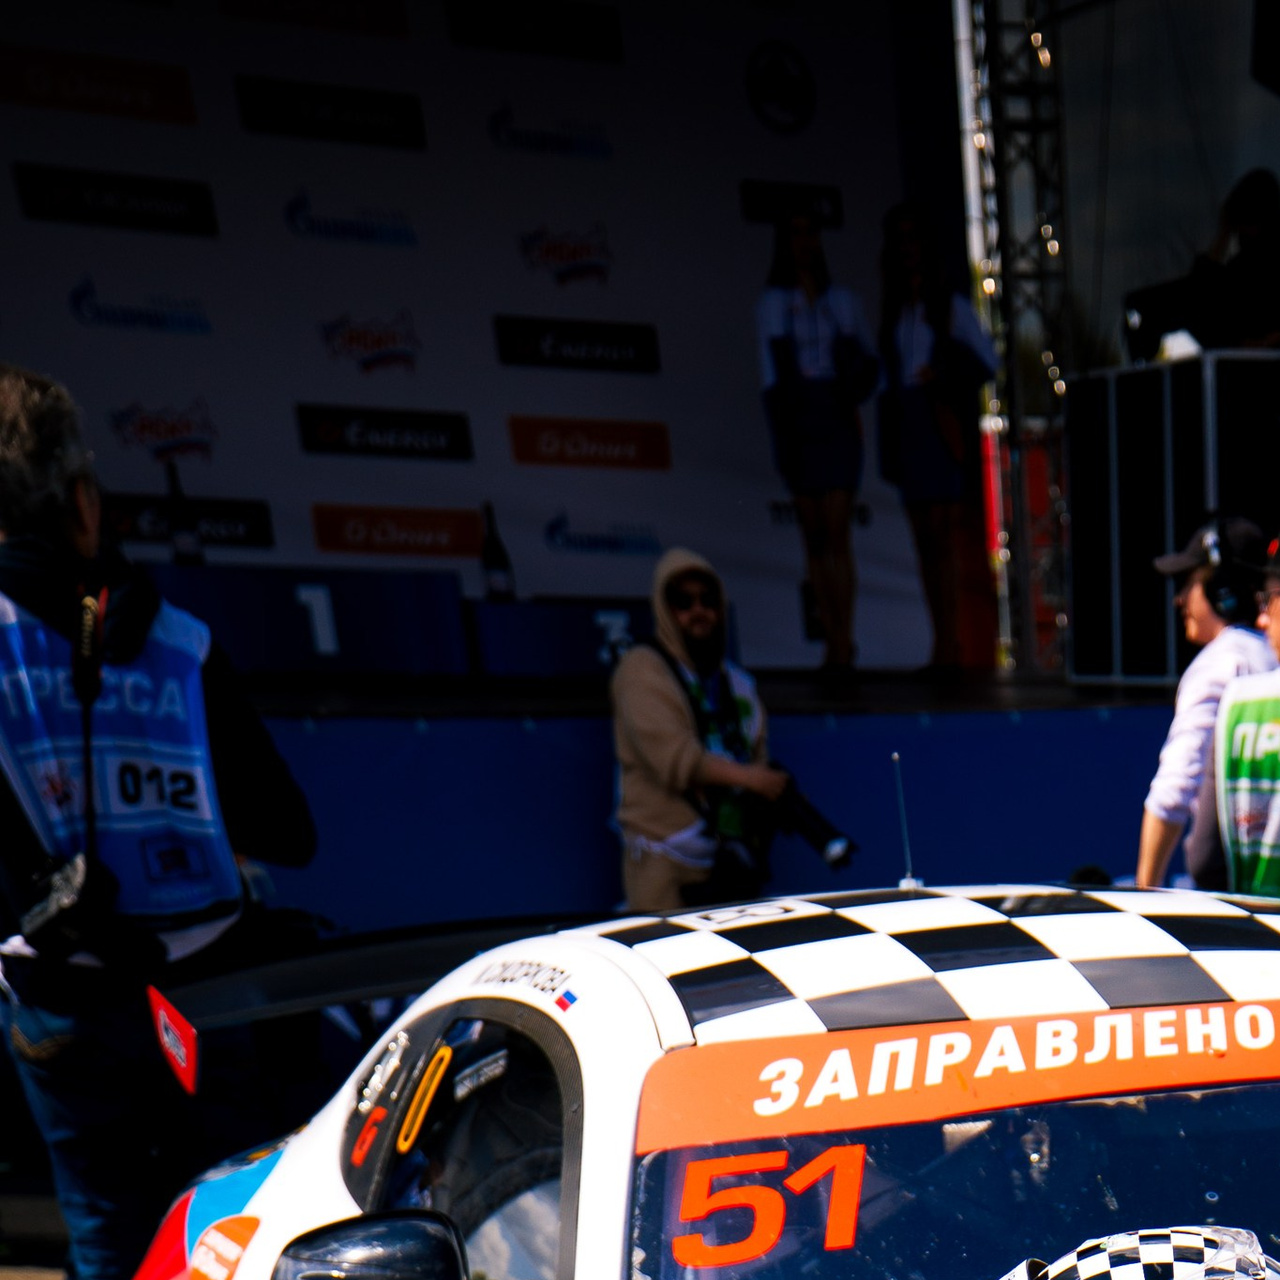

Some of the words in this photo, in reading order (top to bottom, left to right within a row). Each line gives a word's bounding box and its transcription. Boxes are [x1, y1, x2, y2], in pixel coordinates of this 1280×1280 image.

[295, 582, 341, 657] 1
[119, 762, 198, 810] 012
[753, 1003, 1277, 1117] ЗАПРАВЛЕНО
[671, 1142, 868, 1270] 51
